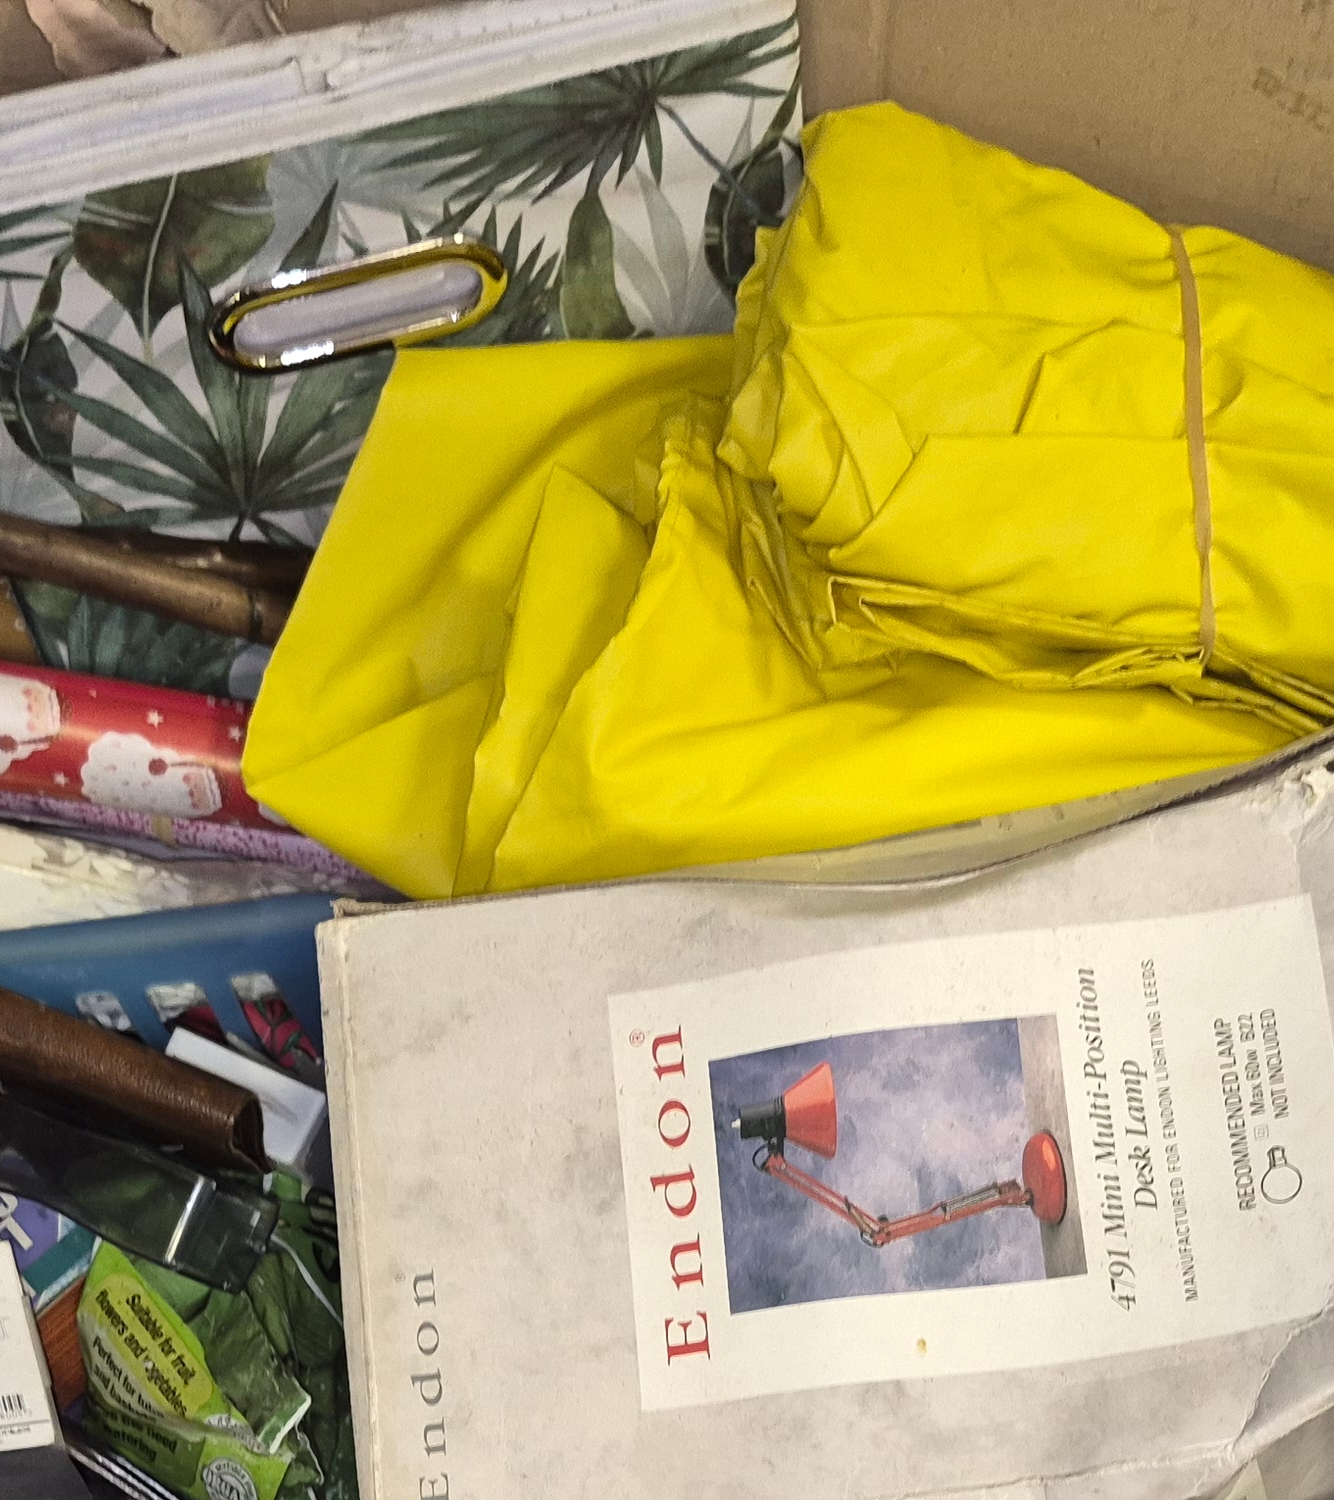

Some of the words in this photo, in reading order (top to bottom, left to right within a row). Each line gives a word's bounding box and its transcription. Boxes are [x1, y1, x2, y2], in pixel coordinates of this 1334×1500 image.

[1141, 958, 1159, 1007] LEEDS
[1077, 967, 1116, 1165] Multi-Position
[1214, 1017, 1237, 1070] LAMP
[1259, 1008, 1287, 1084] INCLUDED
[1120, 1059, 1148, 1139] Lamp
[1158, 1085, 1177, 1140] ENDON
[1247, 1080, 1266, 1116] Max
[1270, 1087, 1290, 1120] NOT
[1165, 1143, 1181, 1173] FOR
[1221, 1070, 1257, 1211] RECOMMENDED
[649, 1024, 711, 1366] Endon
[1097, 1173, 1128, 1240] Mini
[1128, 1144, 1158, 1211] Desk
[1169, 1177, 1199, 1302] MANUFACTURED
[1110, 1248, 1137, 1312] 4791
[95, 1289, 129, 1337] flowers
[124, 1330, 148, 1363] and
[125, 1292, 164, 1343] Suitable
[158, 1336, 176, 1358] for
